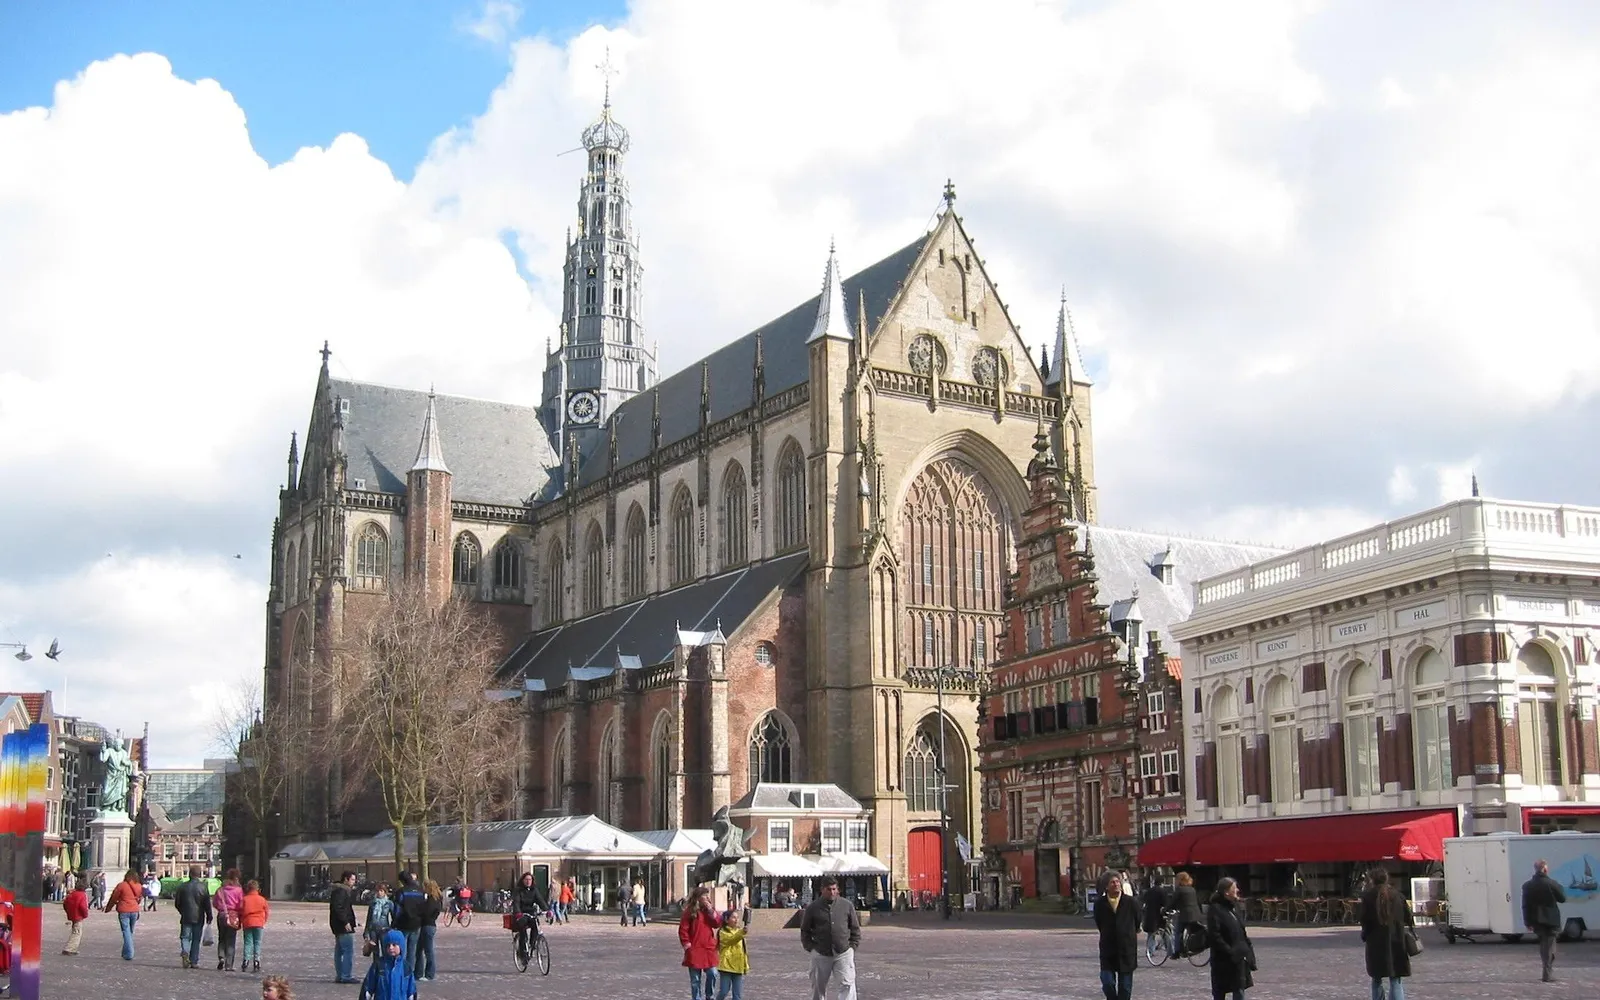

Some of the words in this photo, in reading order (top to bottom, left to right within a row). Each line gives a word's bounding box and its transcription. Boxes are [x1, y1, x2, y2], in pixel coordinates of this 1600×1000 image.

[1413, 608, 1430, 621] HAL
[1339, 622, 1368, 637] VERWEY
[1267, 640, 1289, 653] KUNST
[1209, 651, 1239, 665] MODERNE
